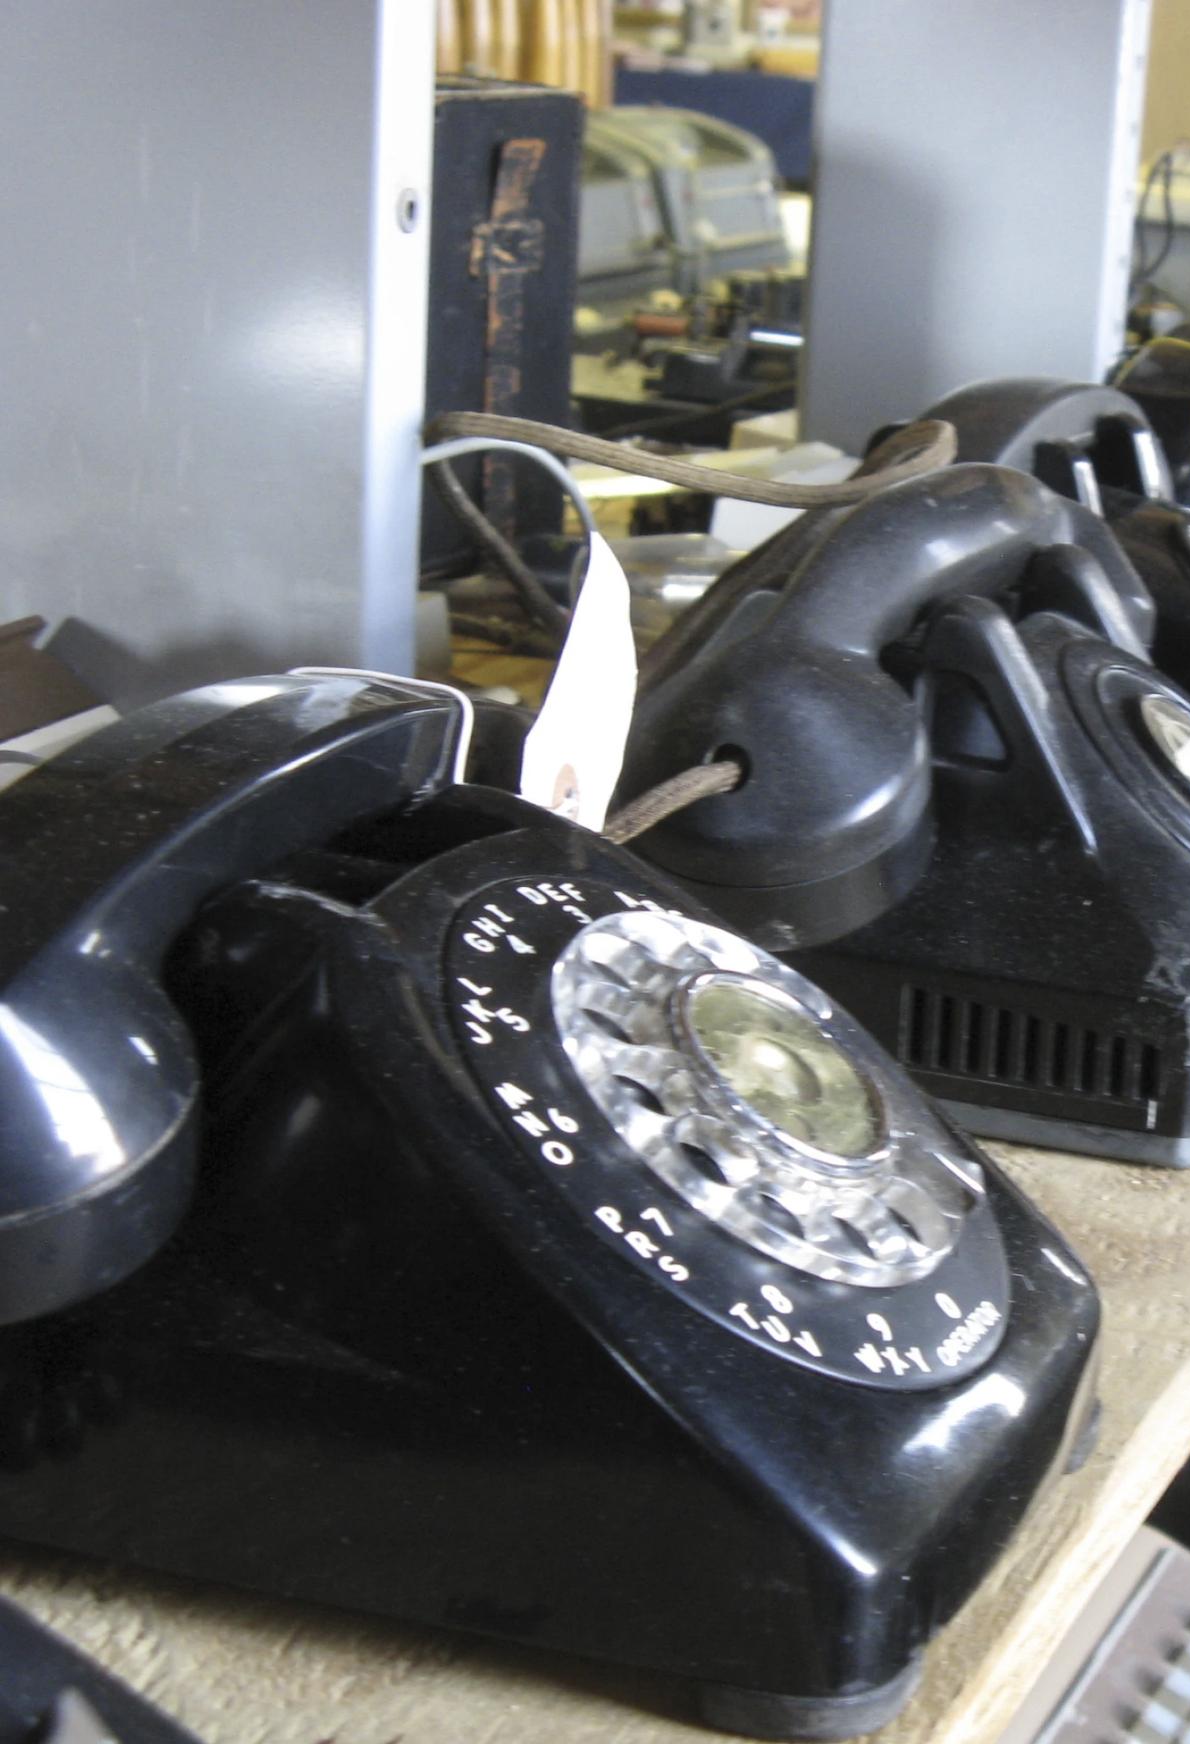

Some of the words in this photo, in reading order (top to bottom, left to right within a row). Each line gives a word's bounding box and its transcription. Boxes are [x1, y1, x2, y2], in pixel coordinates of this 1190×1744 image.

[517, 883, 585, 905] DEF
[463, 904, 515, 953] GHI
[562, 904, 593, 924] 3
[505, 934, 536, 954] 4
[457, 978, 499, 1044] JKL
[495, 1007, 531, 1033] 5
[494, 1082, 575, 1166] MNO
[547, 1107, 580, 1134] 6
[640, 1206, 676, 1237] 7
[594, 1206, 690, 1282] PRS
[760, 1284, 794, 1315] 8
[729, 1301, 824, 1358] TUV
[867, 1312, 894, 1343] 9
[854, 1343, 932, 1376] WXY
